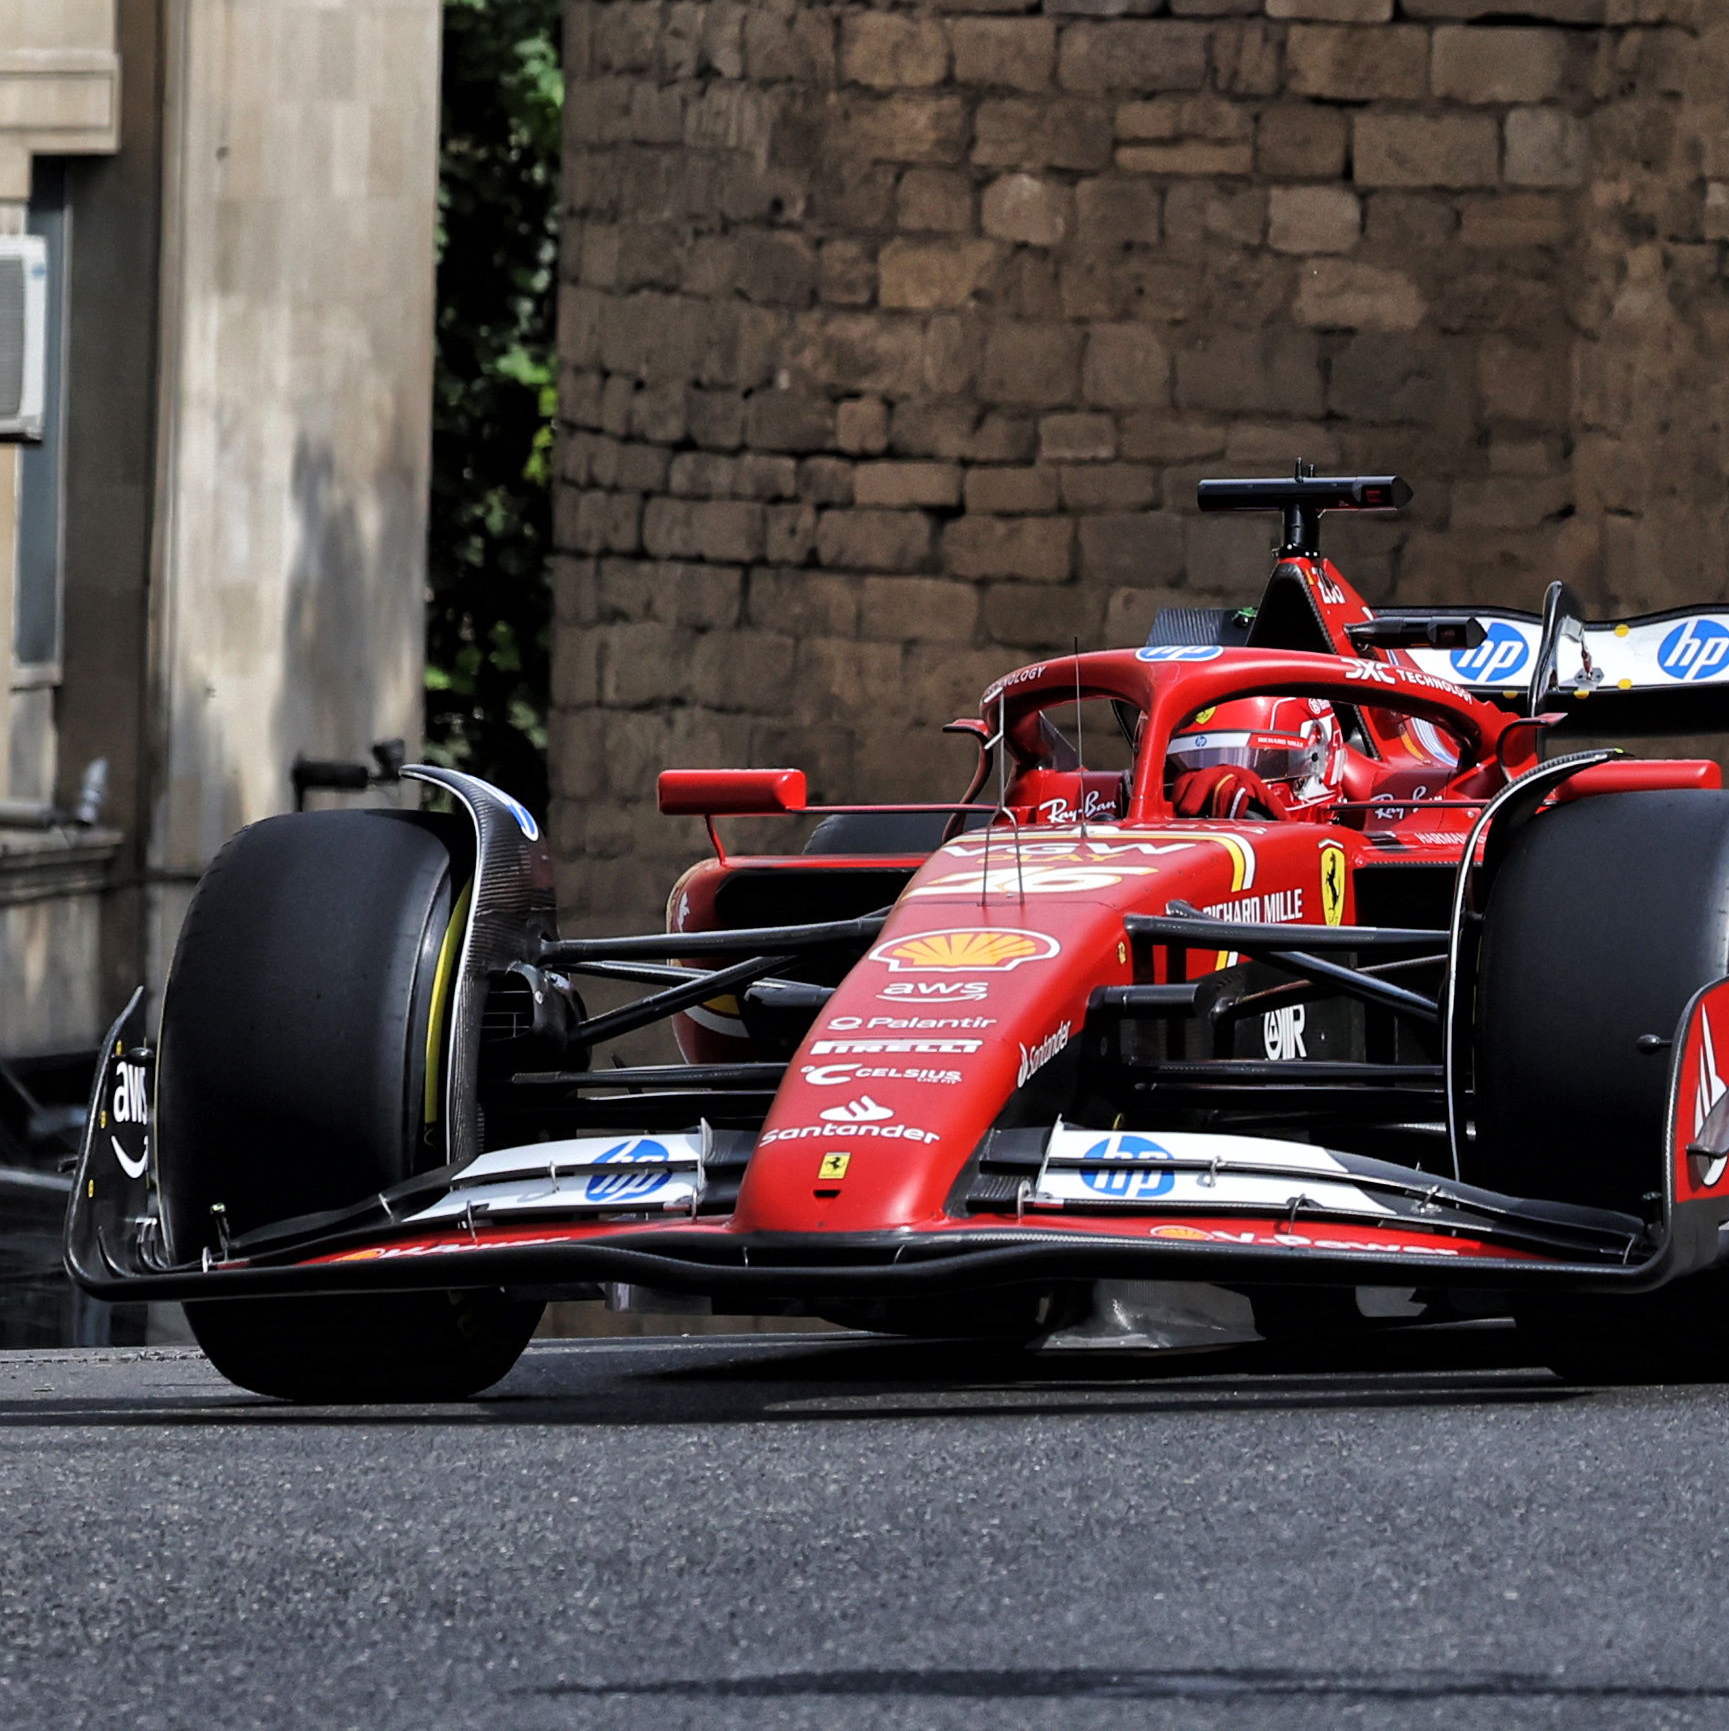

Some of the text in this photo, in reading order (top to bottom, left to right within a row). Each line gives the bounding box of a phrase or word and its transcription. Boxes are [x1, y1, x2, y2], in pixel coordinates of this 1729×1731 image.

[1340, 657, 1473, 705] DXC TECHNOLOGY
[1039, 790, 1117, 824] Ray-Ban
[942, 842, 1197, 857] VGW
[1263, 888, 1303, 923] MILLE
[883, 981, 990, 996] aws
[867, 1016, 997, 1029] Palantir
[809, 1039, 984, 1055] PIRELLI
[1027, 1021, 1072, 1081] Santander
[855, 1067, 962, 1079] CELSIUS
[758, 1123, 941, 1147] Santander
[589, 1139, 667, 1201] hp
[1091, 1135, 1166, 1198] hp
